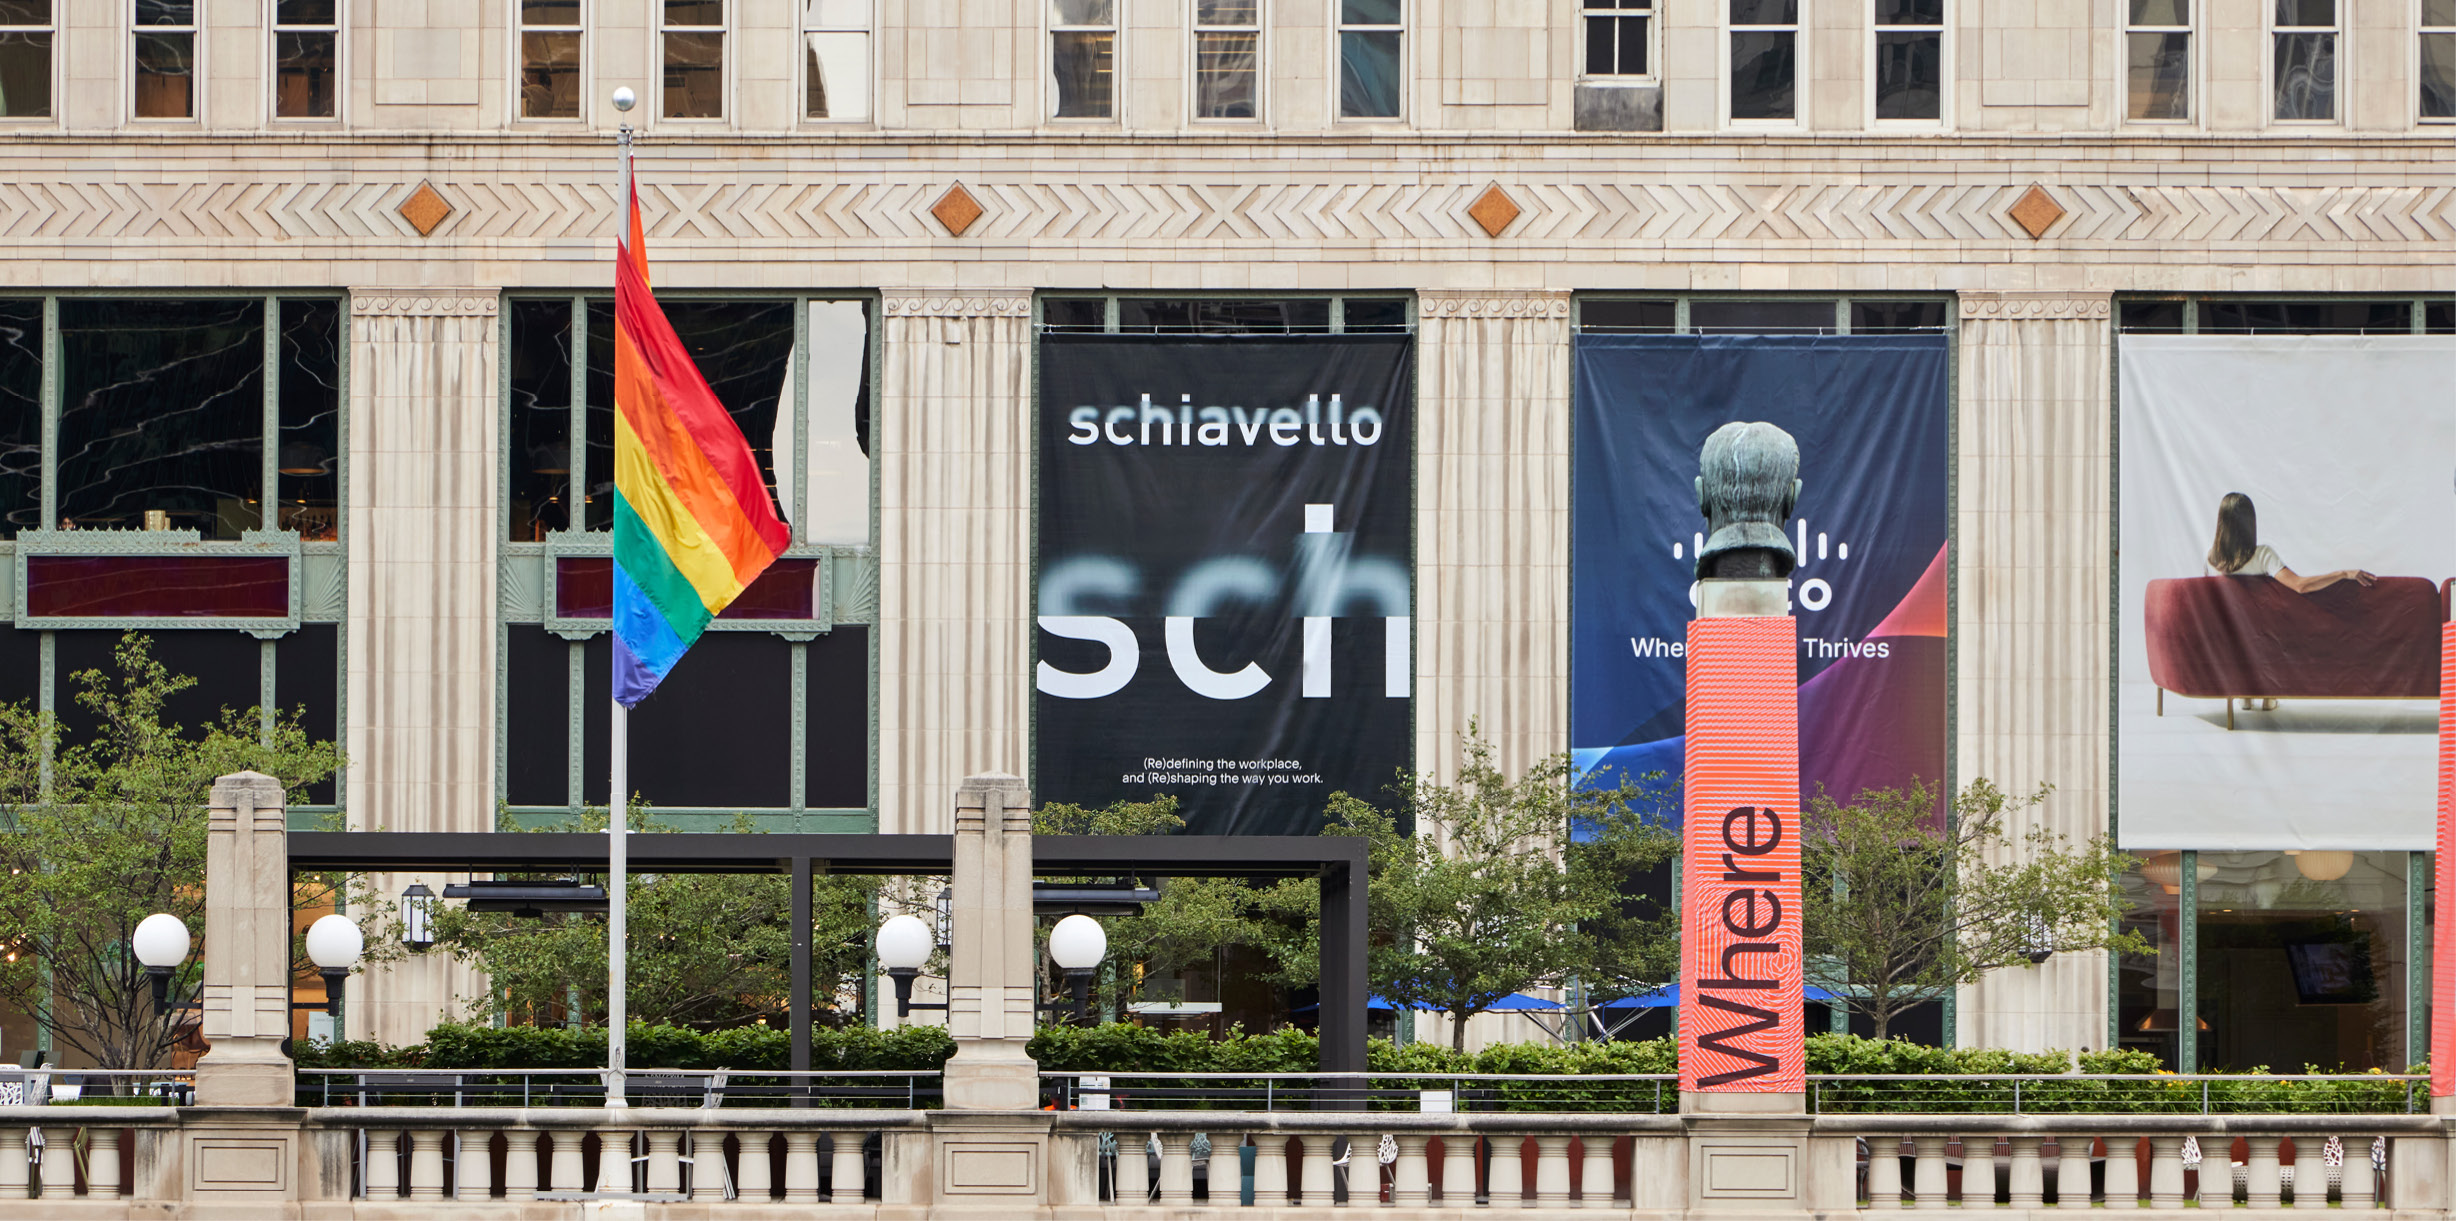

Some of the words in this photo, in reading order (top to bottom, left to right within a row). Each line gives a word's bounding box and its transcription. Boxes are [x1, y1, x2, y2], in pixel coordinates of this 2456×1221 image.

[1067, 393, 1383, 447] schiavello
[1036, 503, 1411, 700] sch
[1630, 637, 1688, 658] Whe
[1803, 637, 1890, 658] Thrives
[1122, 772, 1145, 784] and
[1147, 772, 1217, 786] (Re)shaping
[1219, 772, 1240, 784] the
[1241, 774, 1266, 786] way
[1267, 774, 1290, 786] you
[1291, 772, 1325, 784] work.
[1143, 757, 1214, 772] (Re)defining
[1216, 758, 1236, 770] the
[1238, 757, 1303, 771] workplace,
[1696, 805, 1783, 1089] Where
